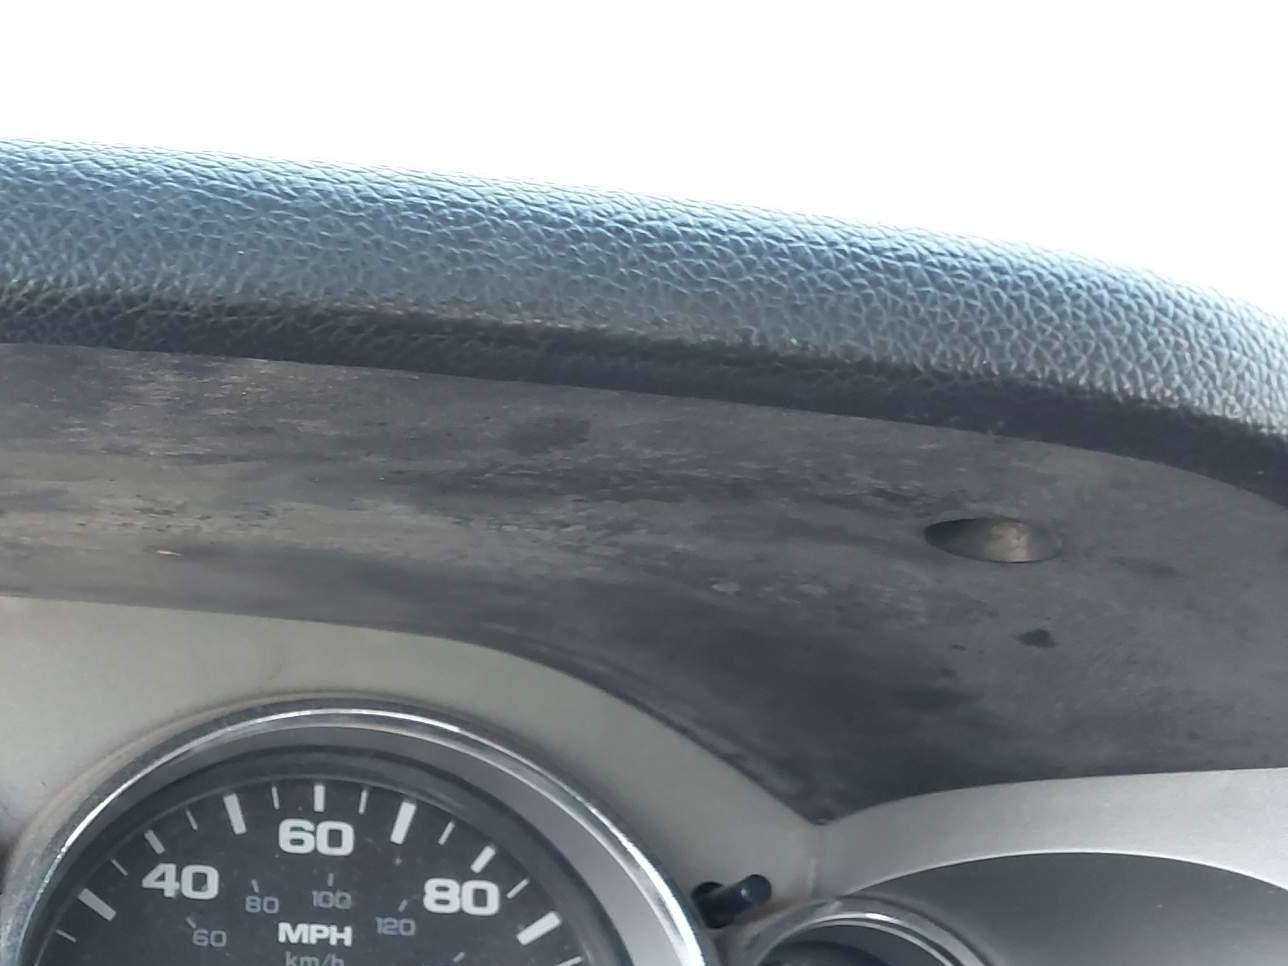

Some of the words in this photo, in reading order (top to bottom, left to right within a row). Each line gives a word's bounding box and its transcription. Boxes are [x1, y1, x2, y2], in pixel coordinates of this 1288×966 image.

[278, 818, 355, 857] 60
[141, 862, 219, 901] 40
[245, 894, 280, 915] 80
[312, 890, 352, 909] 100
[423, 877, 500, 917] 80
[192, 928, 227, 948] 60
[277, 921, 353, 948] MPH
[375, 917, 416, 938] 120
